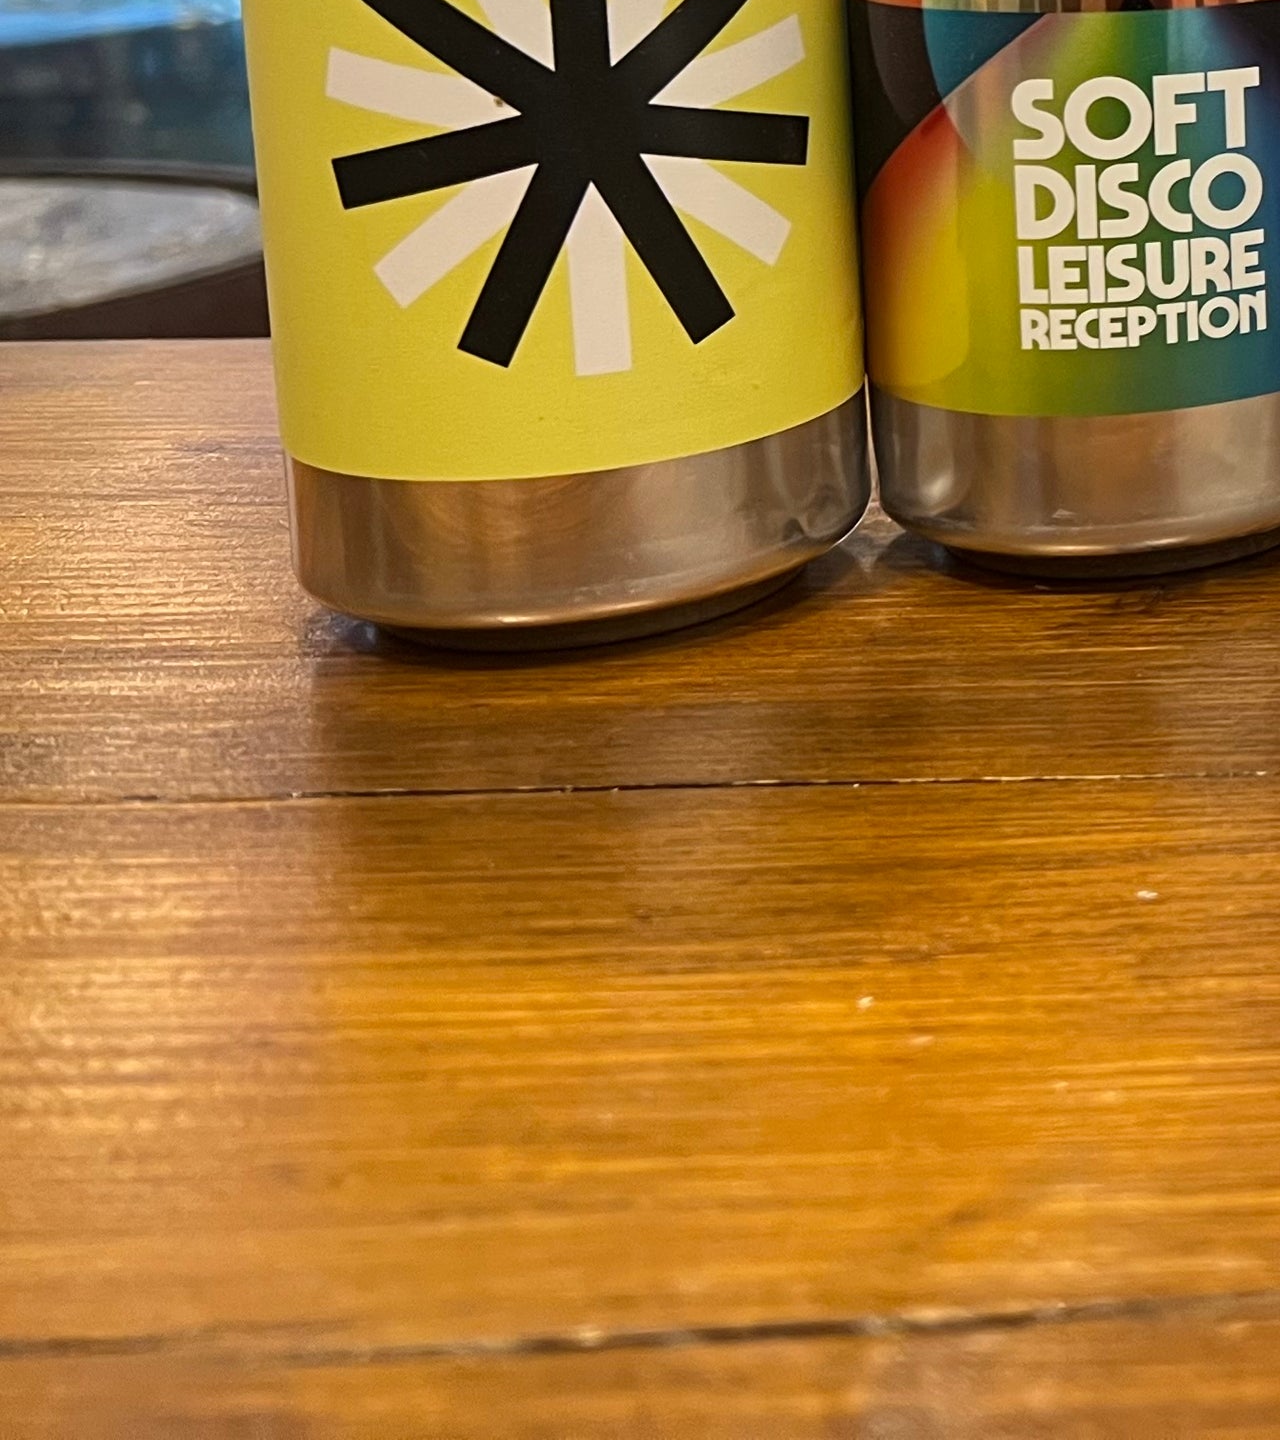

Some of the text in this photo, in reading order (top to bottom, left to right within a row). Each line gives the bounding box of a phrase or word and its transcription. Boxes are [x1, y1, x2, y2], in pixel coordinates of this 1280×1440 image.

[1011, 66, 1260, 161] SOFT
[1012, 153, 1263, 240] DISCO
[1017, 229, 1265, 305] LEISURE
[1020, 285, 1267, 351] RECEPTION
